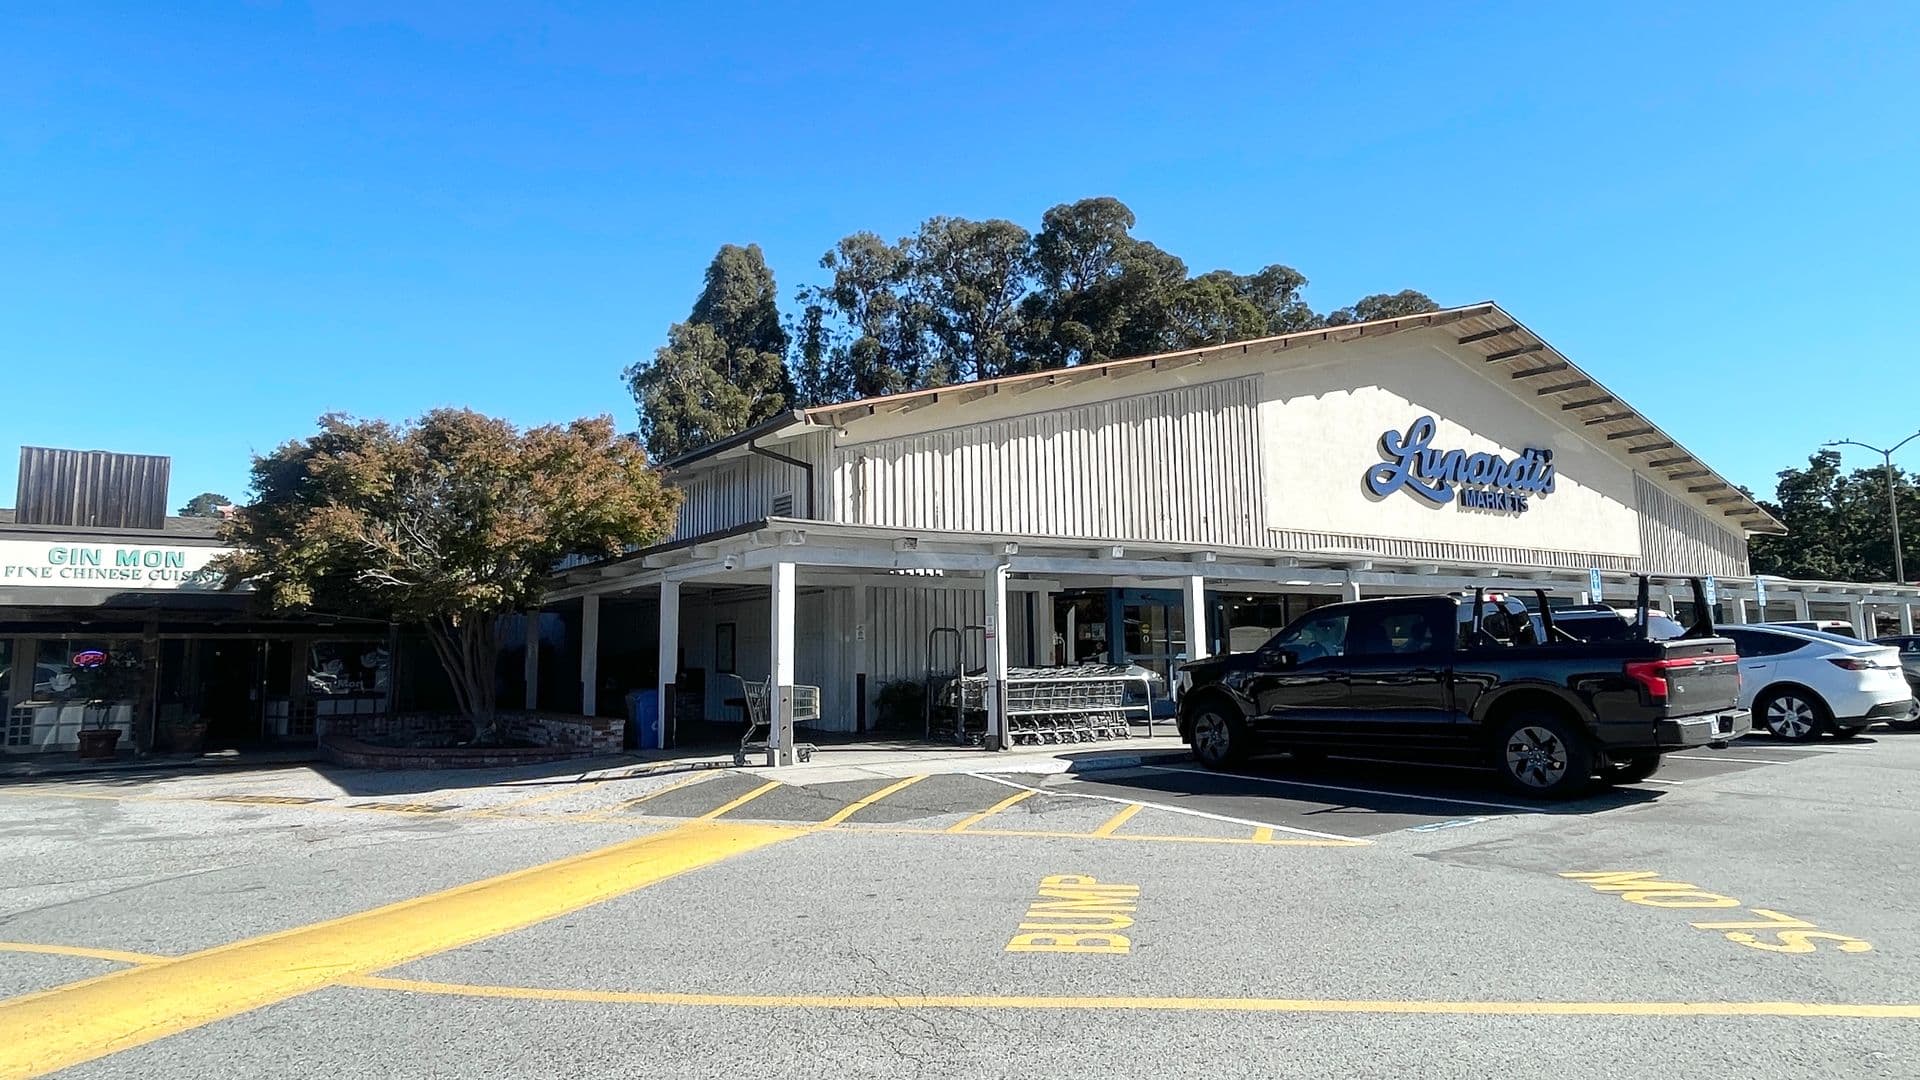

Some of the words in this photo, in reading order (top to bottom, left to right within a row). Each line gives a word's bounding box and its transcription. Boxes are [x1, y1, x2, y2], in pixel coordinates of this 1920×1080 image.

[1461, 488, 1528, 512] MARKETS
[48, 547, 101, 566] GIN
[115, 549, 185, 568] MON
[5, 566, 53, 578] FINE
[60, 568, 141, 580] CHINESE
[1004, 874, 1140, 954] BUMP
[1557, 871, 1873, 953] SLOW
